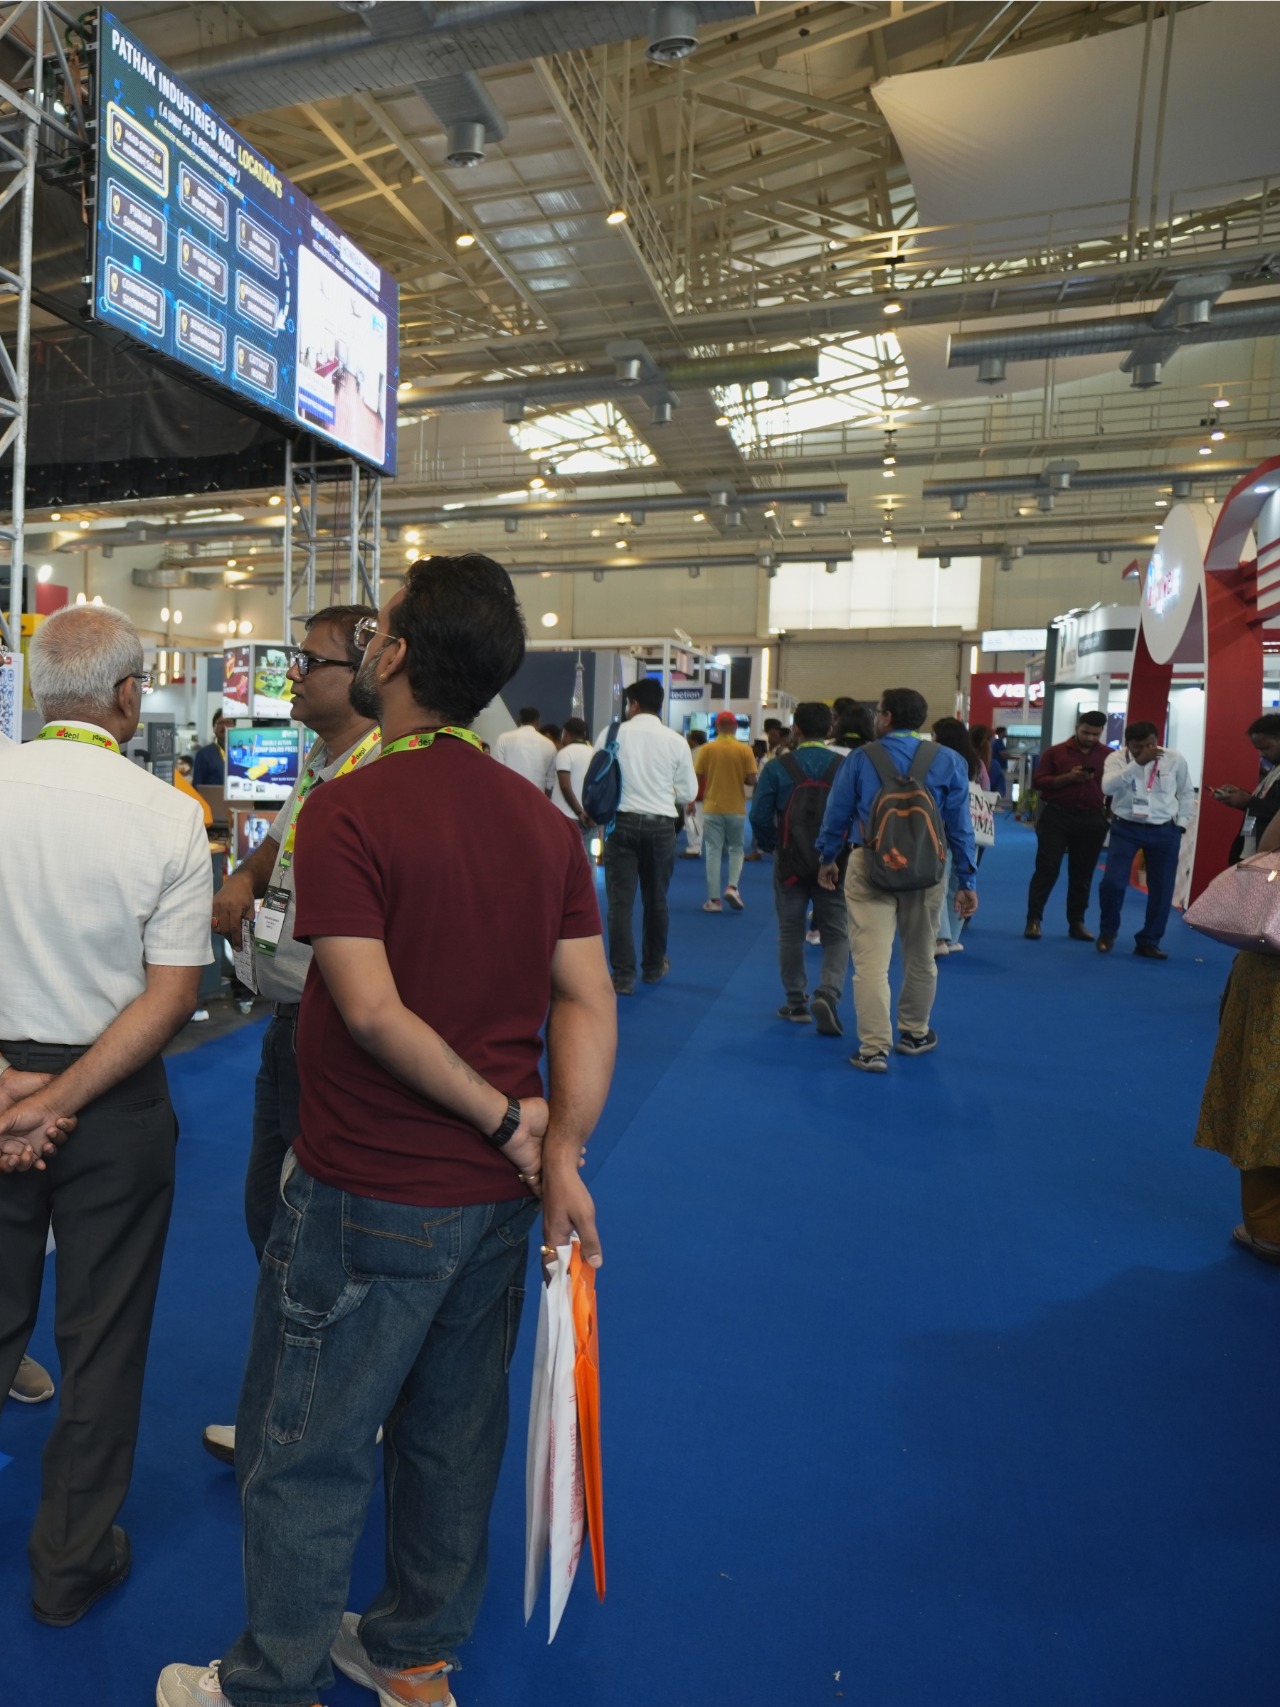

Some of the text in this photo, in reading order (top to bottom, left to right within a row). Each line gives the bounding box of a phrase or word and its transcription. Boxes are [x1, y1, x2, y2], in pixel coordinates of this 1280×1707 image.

[112, 29, 156, 86] PATHAK
[159, 72, 217, 141] INDUSTRIES
[218, 128, 237, 159] KOL
